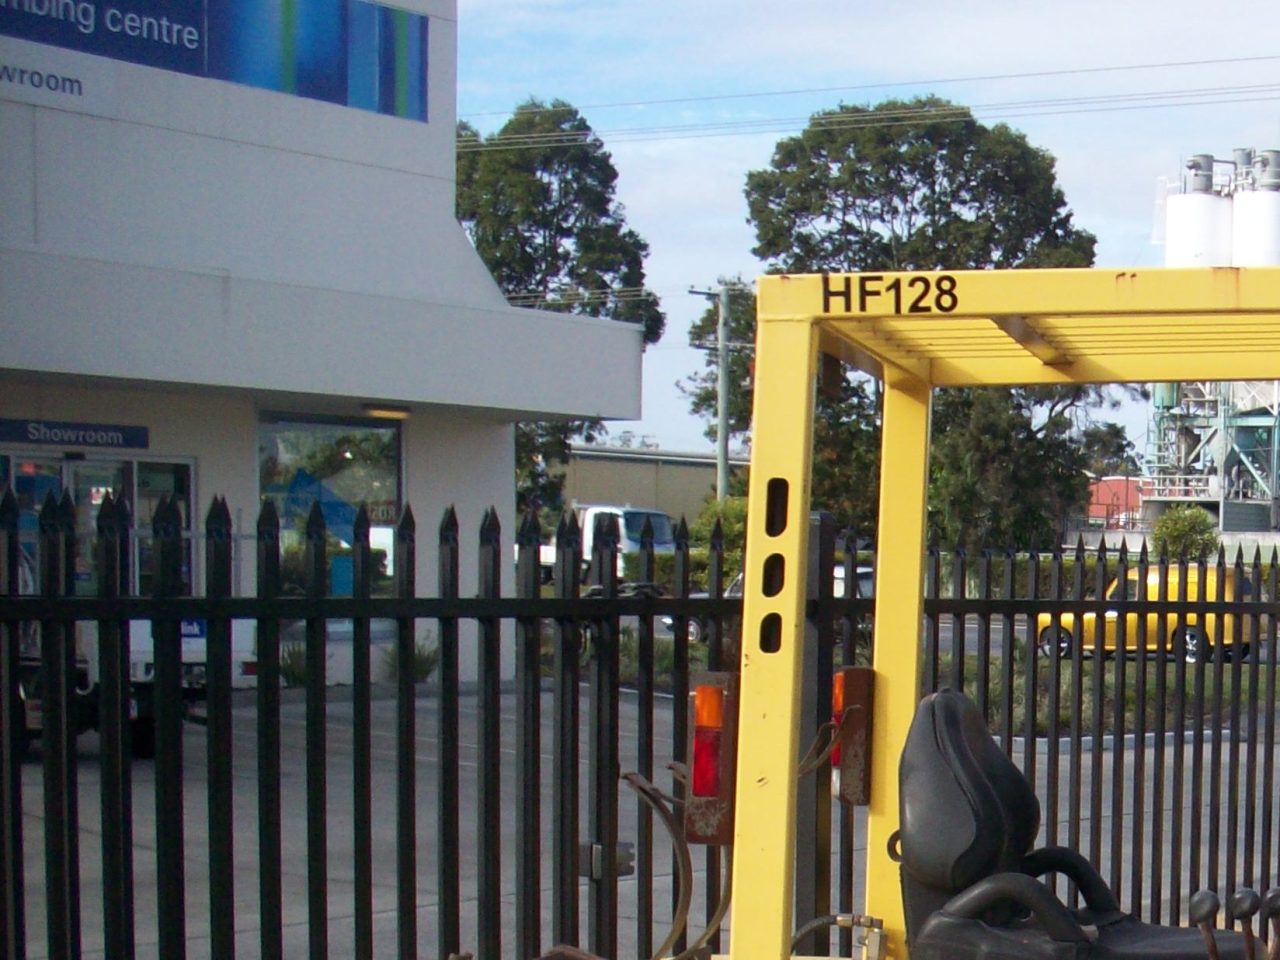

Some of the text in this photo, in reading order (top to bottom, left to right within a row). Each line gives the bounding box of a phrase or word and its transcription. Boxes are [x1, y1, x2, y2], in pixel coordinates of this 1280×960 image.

[104, 8, 199, 49] centre
[821, 271, 958, 314] HF128
[27, 422, 124, 444] Showroom
